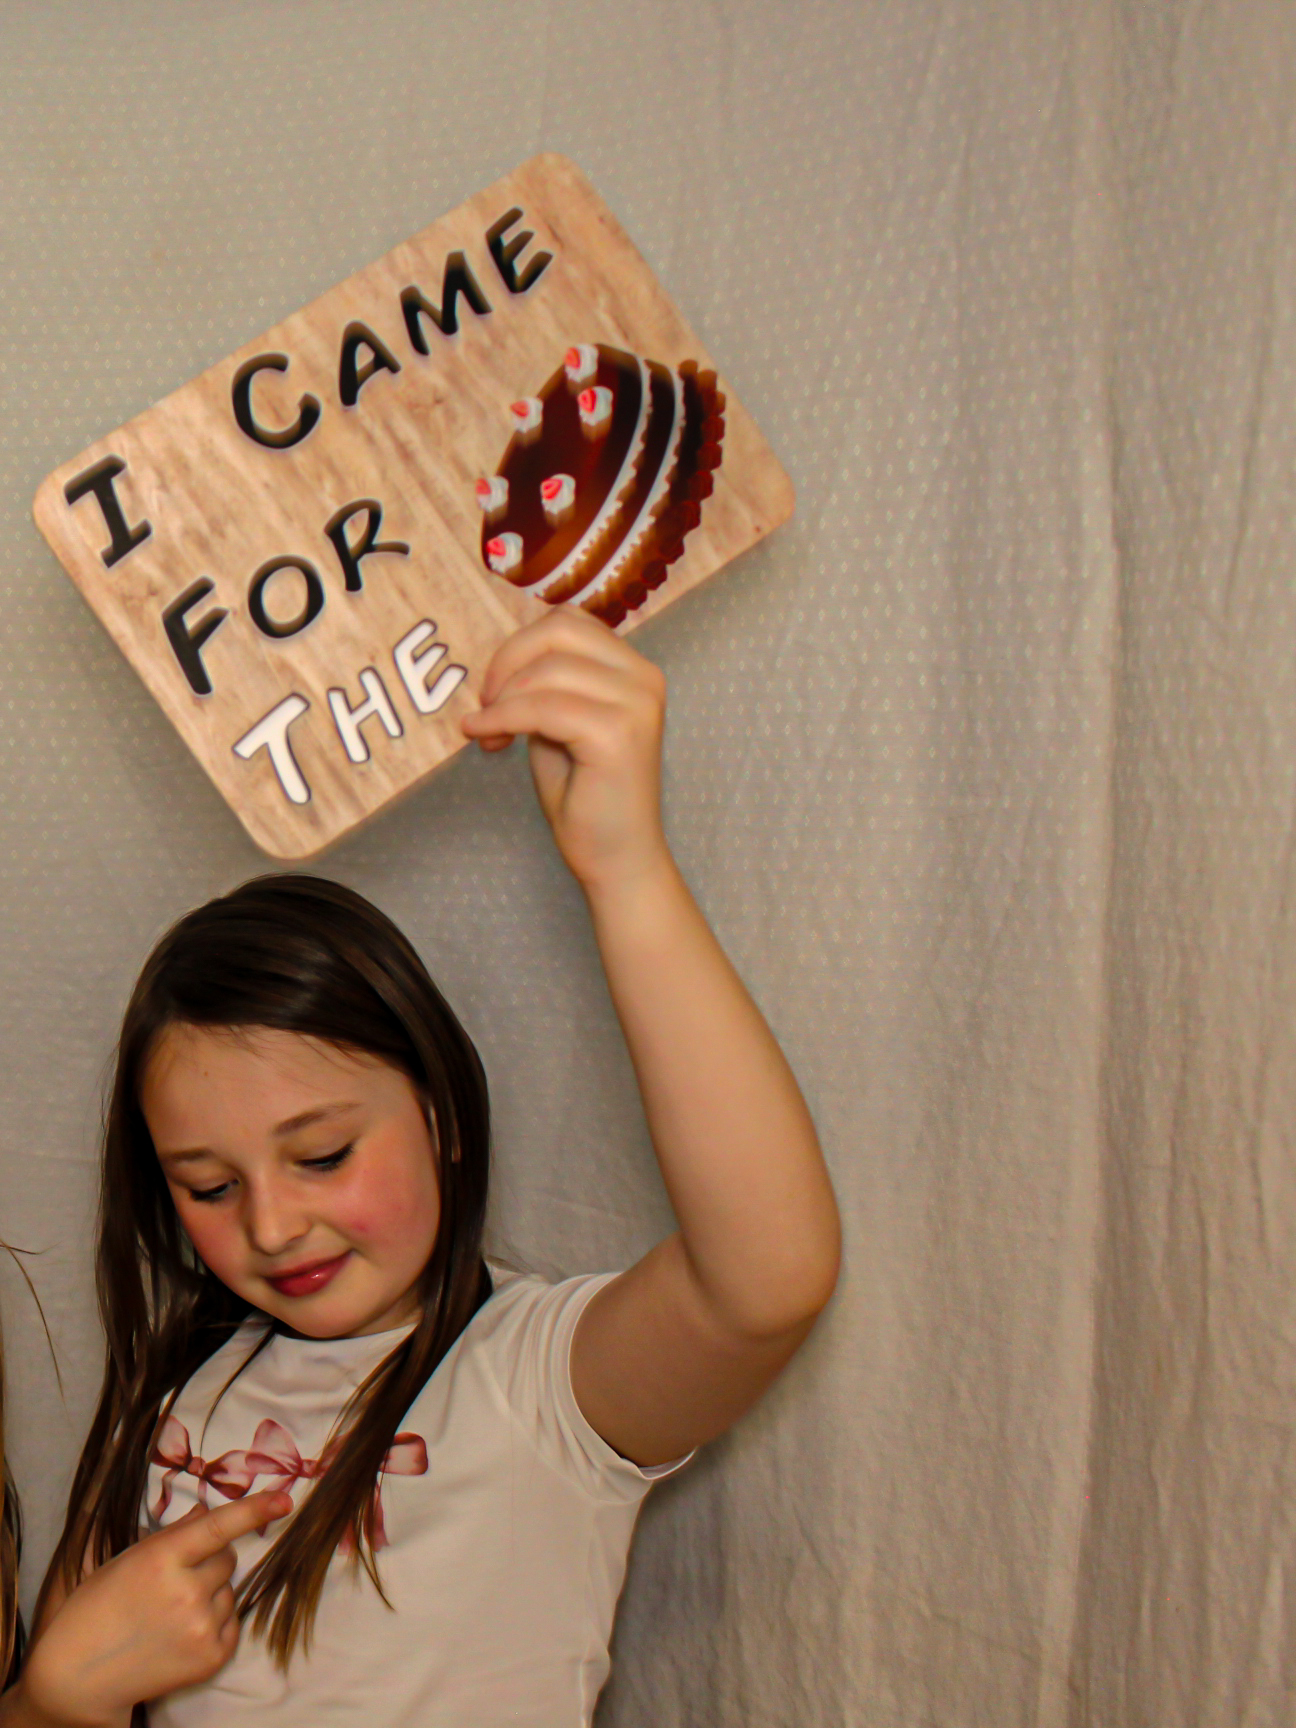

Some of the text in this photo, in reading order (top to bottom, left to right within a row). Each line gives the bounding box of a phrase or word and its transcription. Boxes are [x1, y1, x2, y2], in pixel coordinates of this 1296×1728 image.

[62, 206, 554, 570] I CAME
[160, 498, 412, 697] FOR
[231, 618, 470, 806] THE
